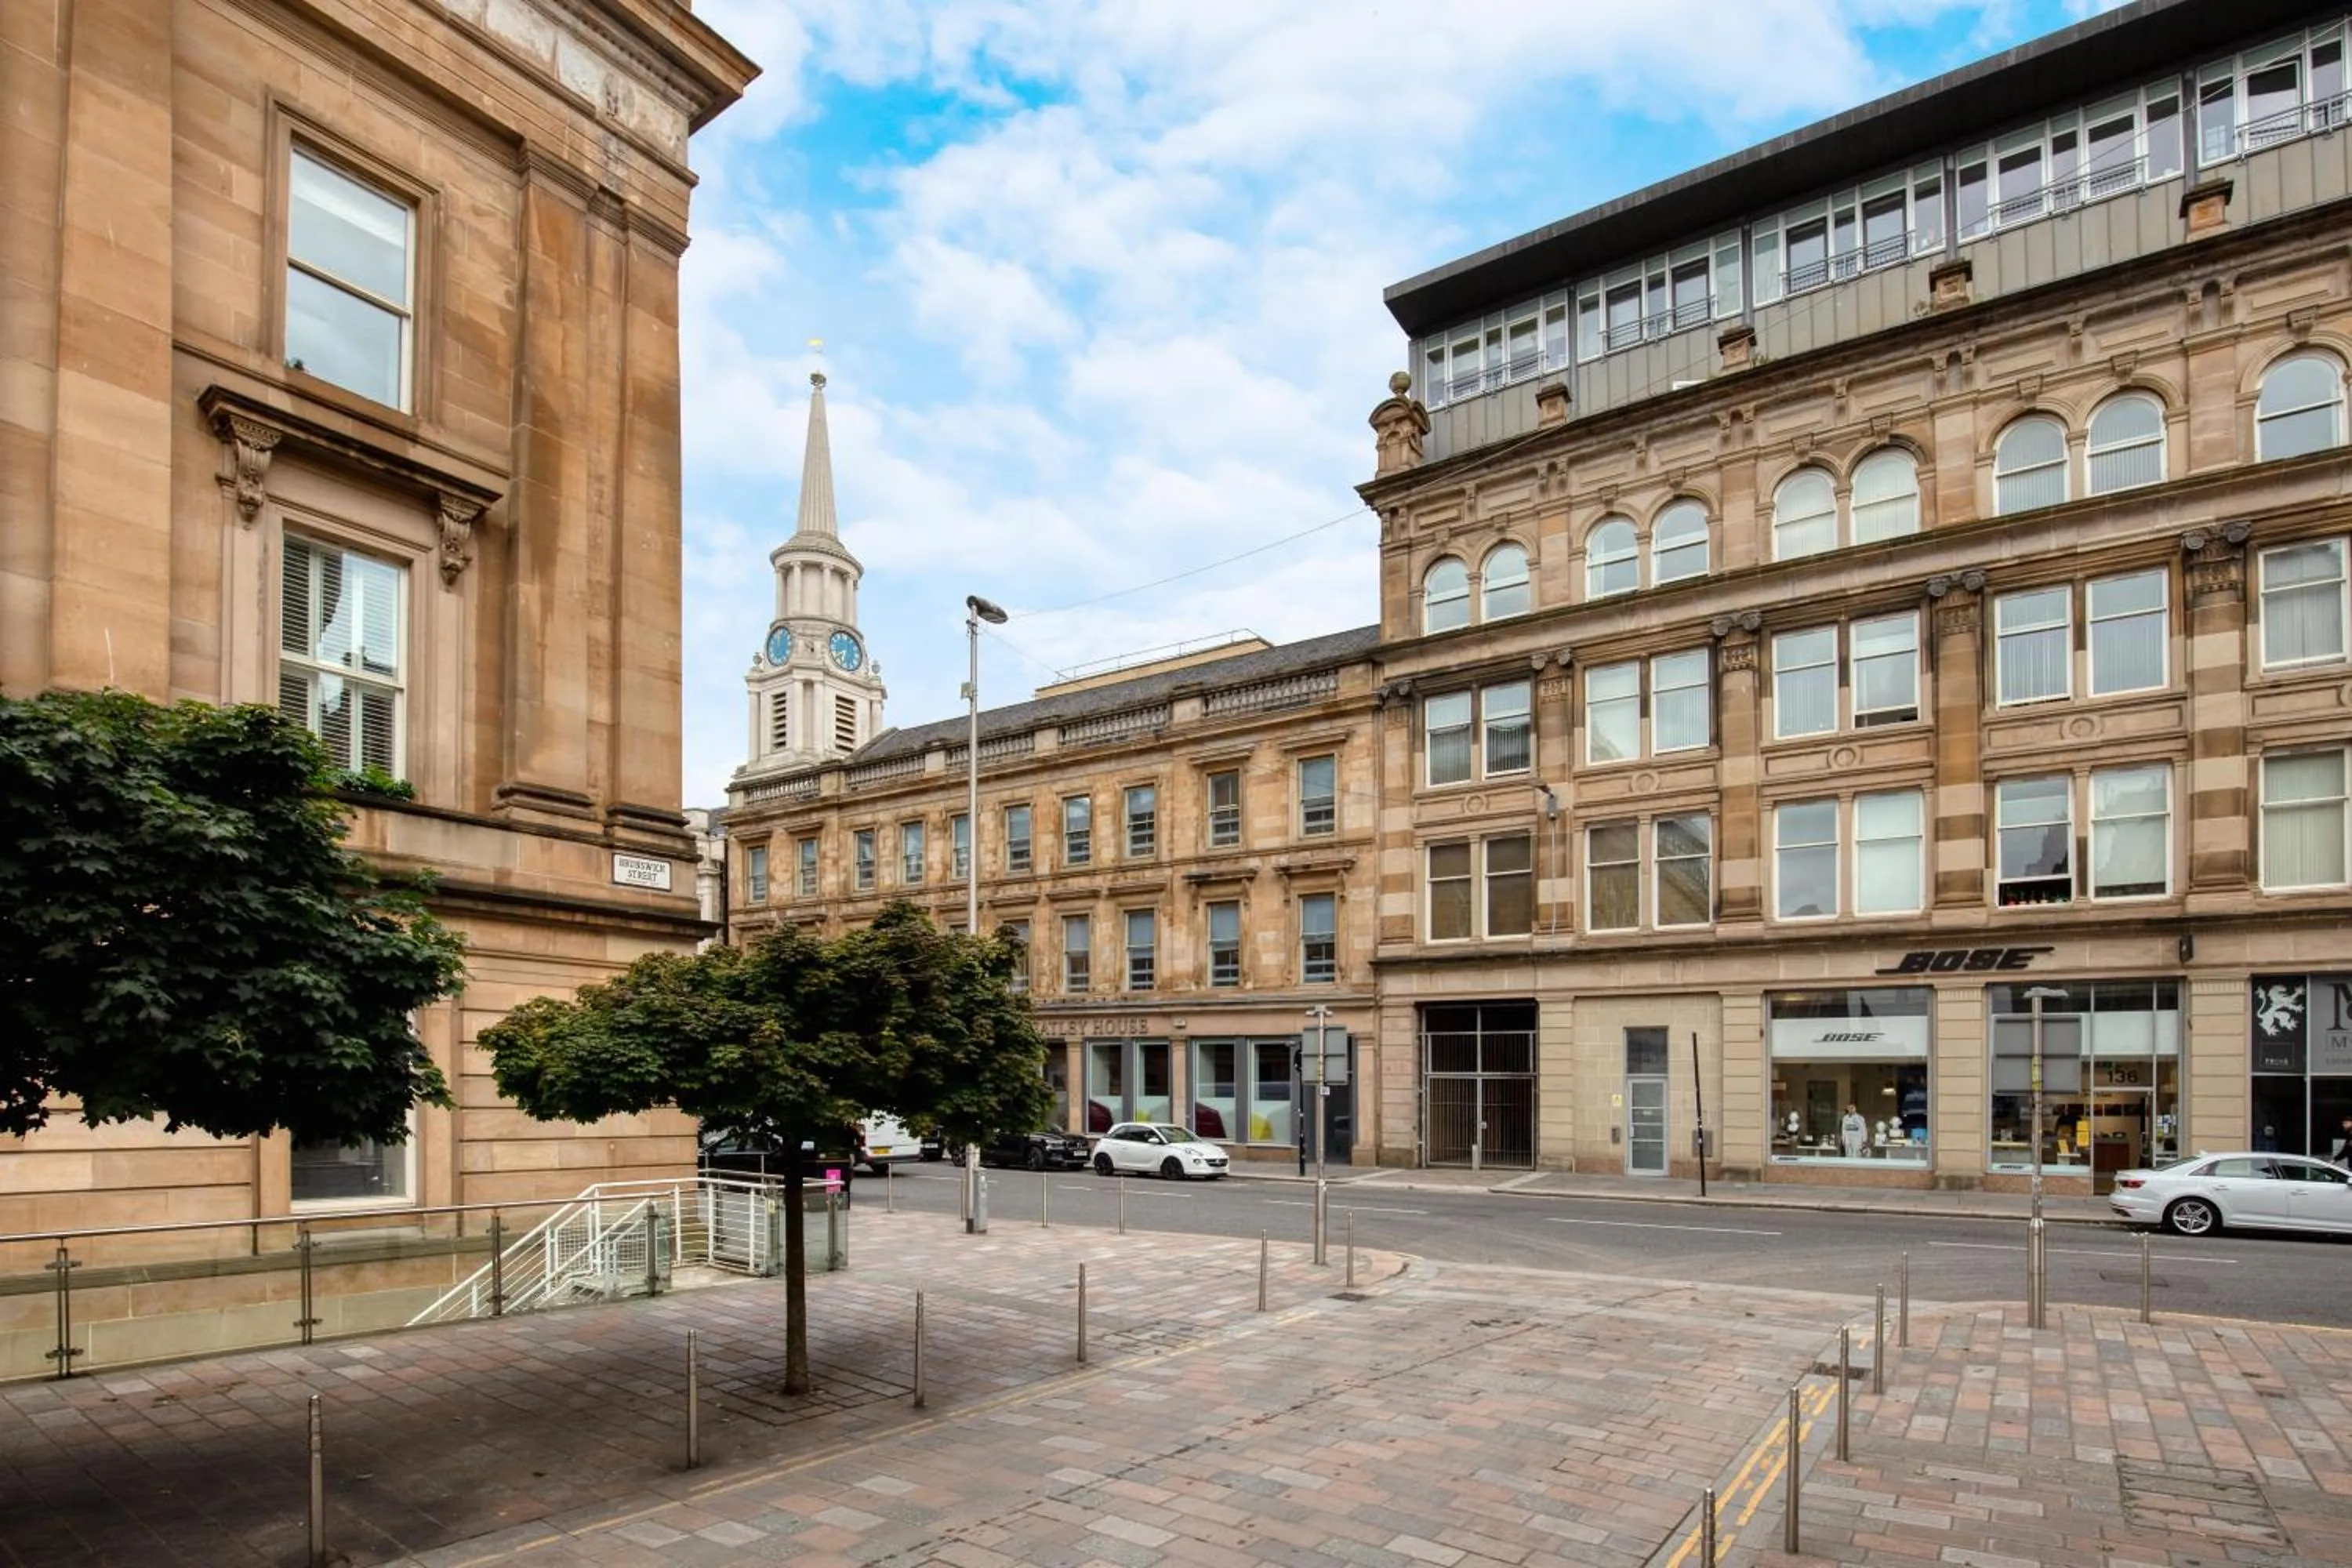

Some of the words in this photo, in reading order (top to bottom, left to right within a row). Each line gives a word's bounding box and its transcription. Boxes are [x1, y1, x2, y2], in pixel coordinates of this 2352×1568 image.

[627, 869, 657, 882] STREET
[1875, 946, 2055, 975] BOSE
[1093, 1018, 1149, 1035] HOUSE
[1812, 1033, 1886, 1043] BOSE
[2107, 1069, 2139, 1083] 136
